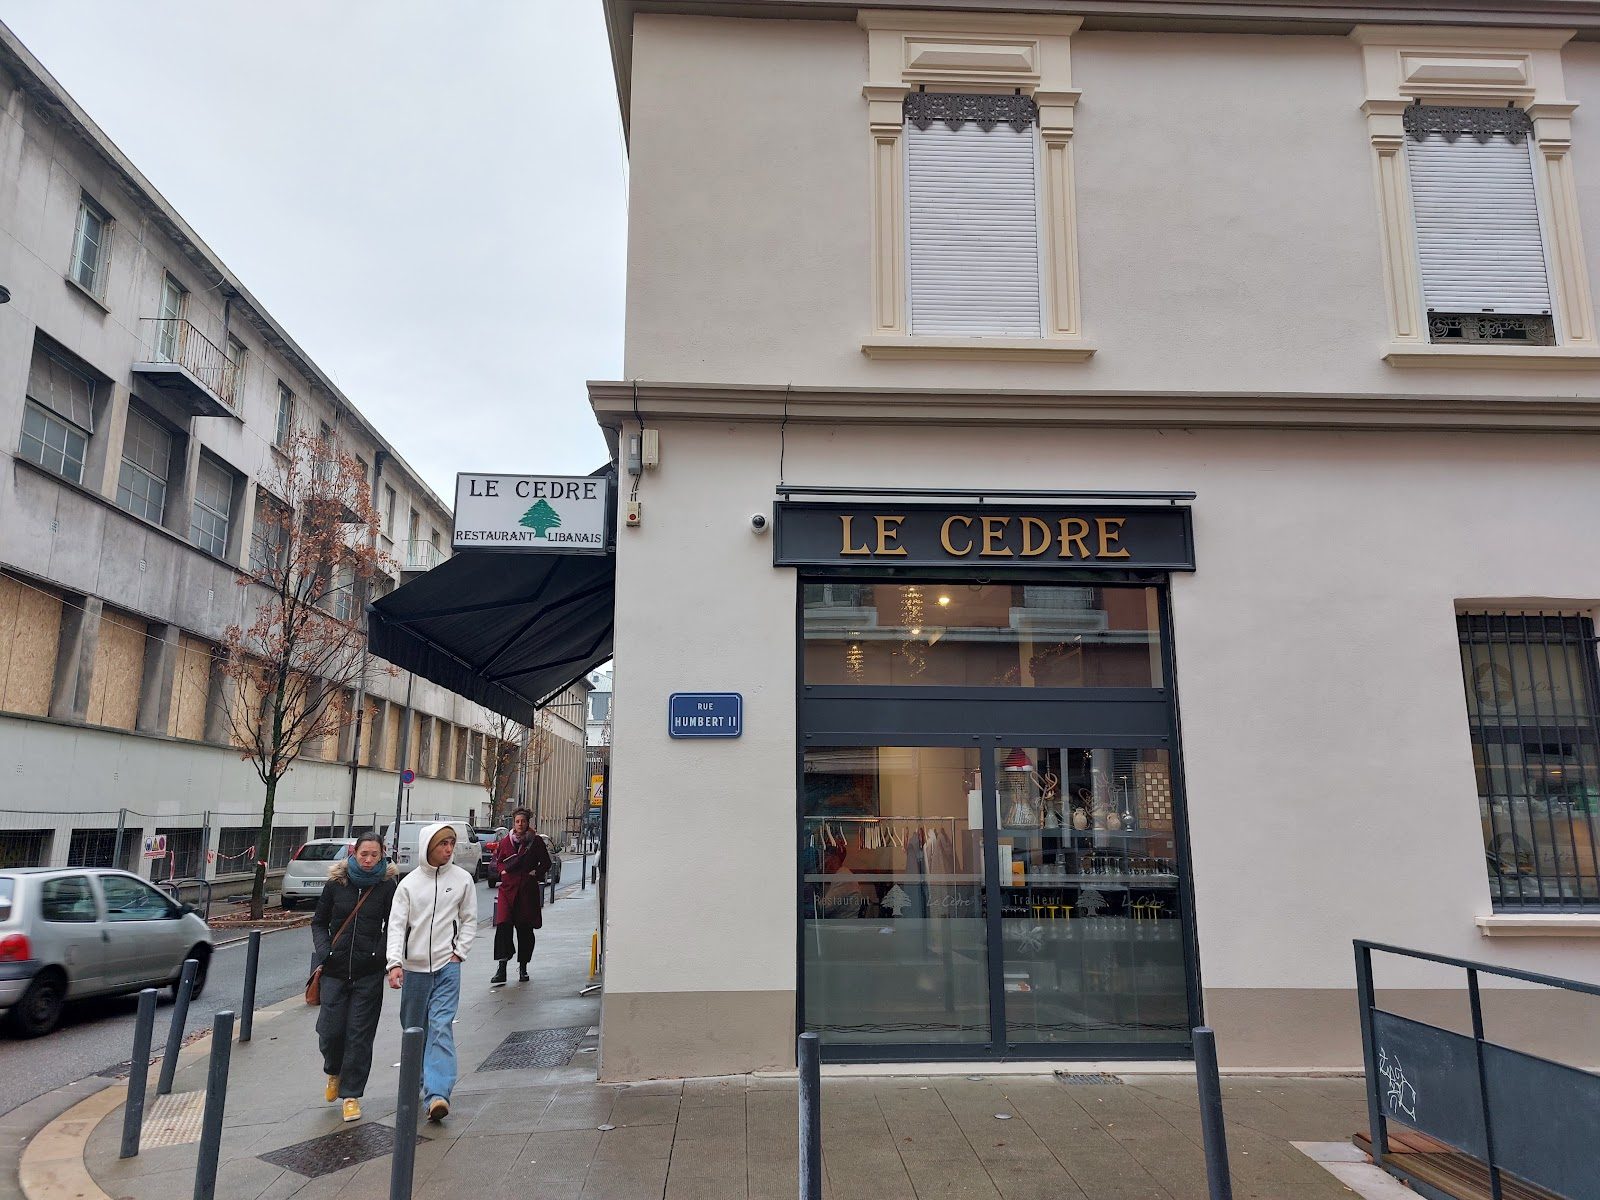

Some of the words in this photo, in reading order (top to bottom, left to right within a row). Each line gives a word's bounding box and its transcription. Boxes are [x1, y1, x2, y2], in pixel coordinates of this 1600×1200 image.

[469, 479, 499, 497] LE
[515, 480, 597, 500] CEDRE
[455, 530, 534, 542] RESTAURANT
[547, 532, 602, 543] LIBANAIS
[839, 515, 908, 556] LE
[940, 515, 1131, 559] CEDRE
[697, 702, 714, 711] RUE
[674, 716, 724, 727] HUMBERT
[728, 716, 736, 727] II
[814, 895, 870, 907] Restaurant
[1013, 894, 1061, 905] Traiteur
